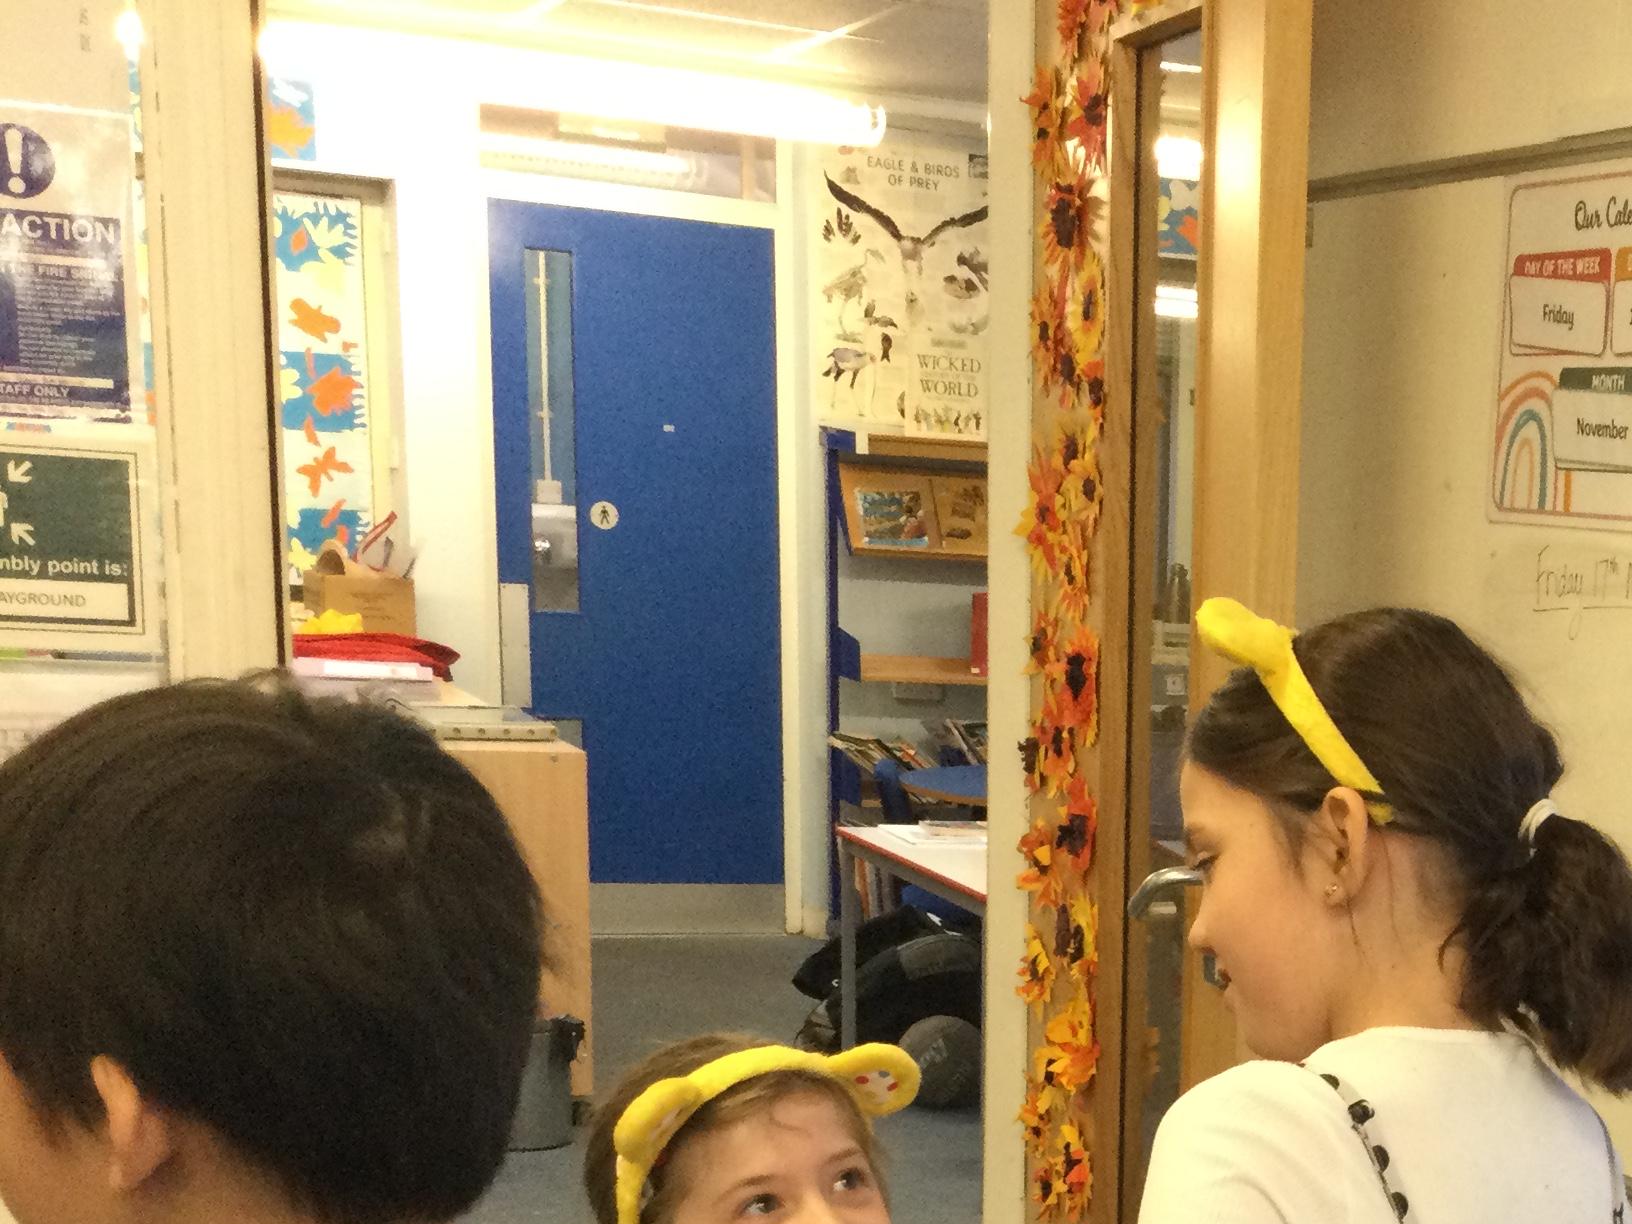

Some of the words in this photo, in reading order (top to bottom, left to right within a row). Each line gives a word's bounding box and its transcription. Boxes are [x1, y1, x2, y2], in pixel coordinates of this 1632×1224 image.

[867, 156, 905, 172] EAGLE
[924, 163, 960, 178] BIRDS
[888, 174, 904, 186] OF
[909, 177, 941, 191] PREY
[1574, 200, 1602, 231] Our
[1, 212, 115, 244] ACTION
[1525, 261, 1540, 275] DAY
[1543, 260, 1555, 276] OF
[1557, 258, 1574, 275] THE
[1575, 256, 1601, 275] WEEK
[1543, 303, 1575, 331] Friday
[917, 353, 981, 373] WICKED
[33, 384, 70, 398] ONLY
[920, 379, 979, 398] WORLD
[1592, 374, 1626, 392] MONTH
[1576, 417, 1629, 441] November
[48, 558, 99, 577] point
[105, 560, 128, 577] is:
[1536, 544, 1584, 640] Friday
